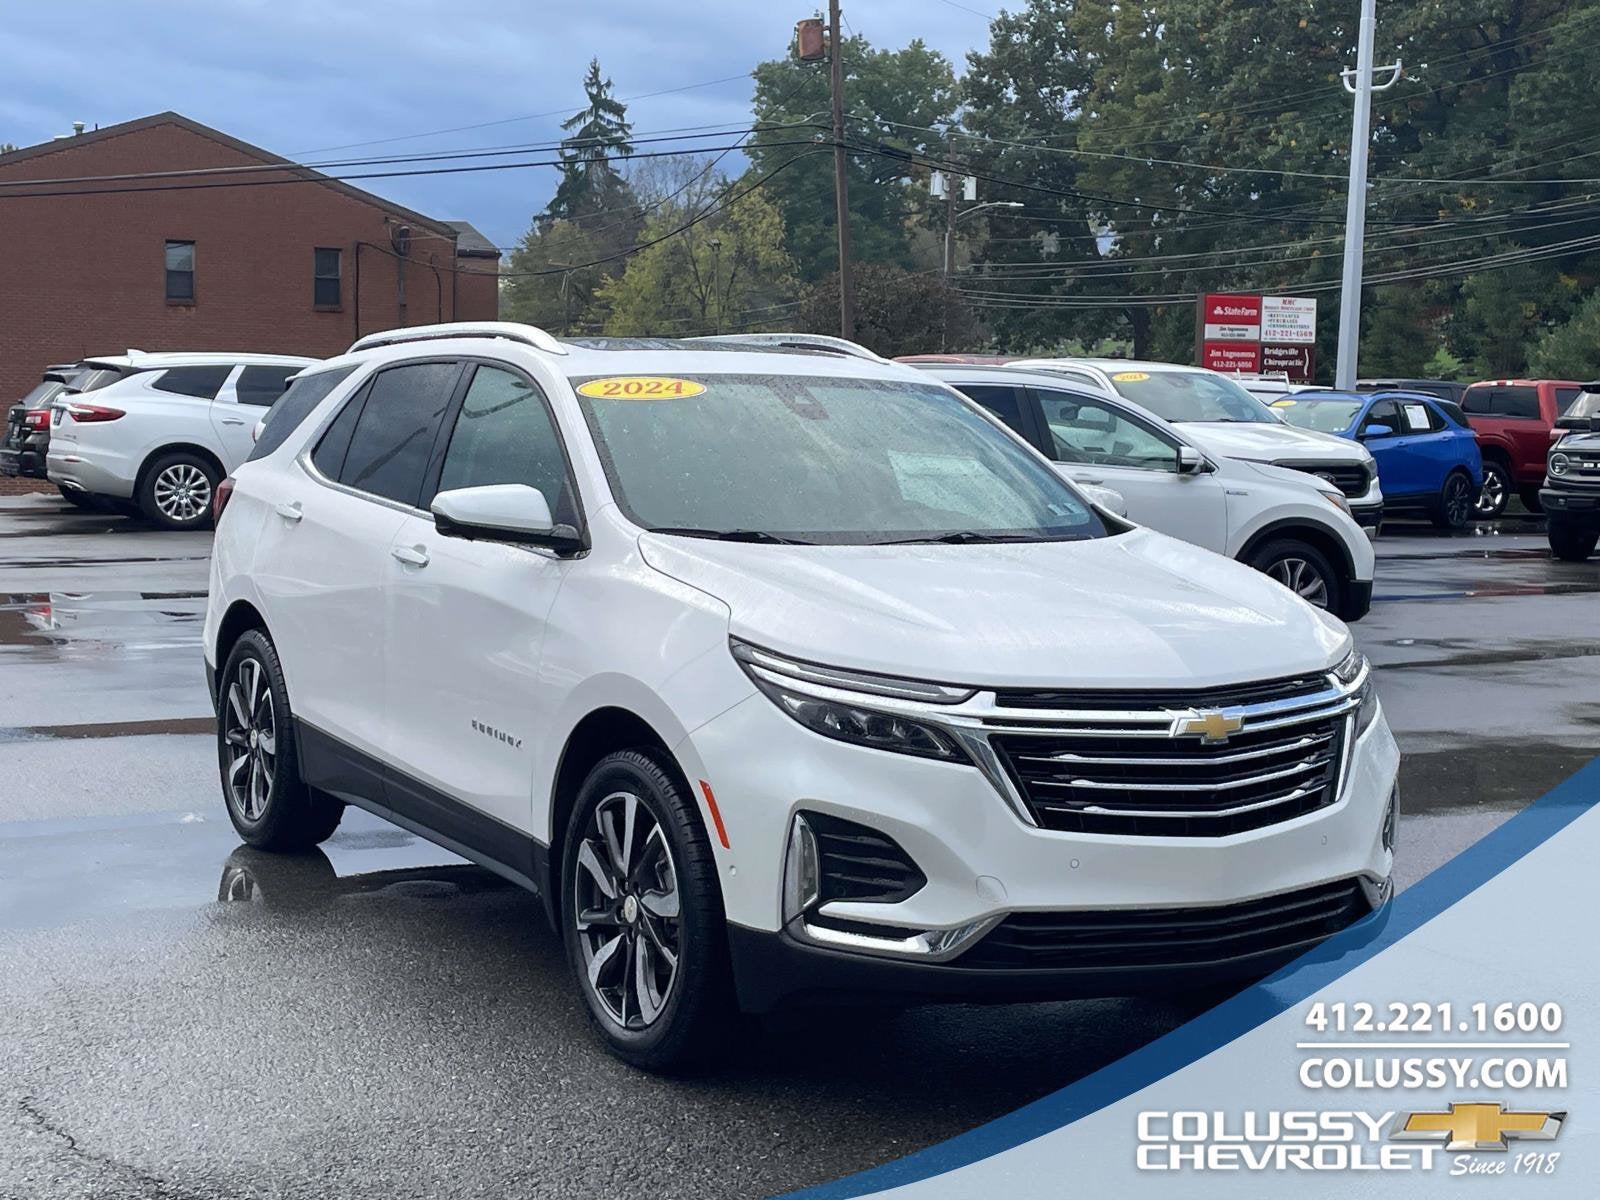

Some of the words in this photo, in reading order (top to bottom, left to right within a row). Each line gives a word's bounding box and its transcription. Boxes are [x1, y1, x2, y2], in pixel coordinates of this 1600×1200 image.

[1264, 348, 1299, 356] Bridgeville
[1263, 359, 1303, 367] Chiropractic
[603, 382, 682, 395] 2024
